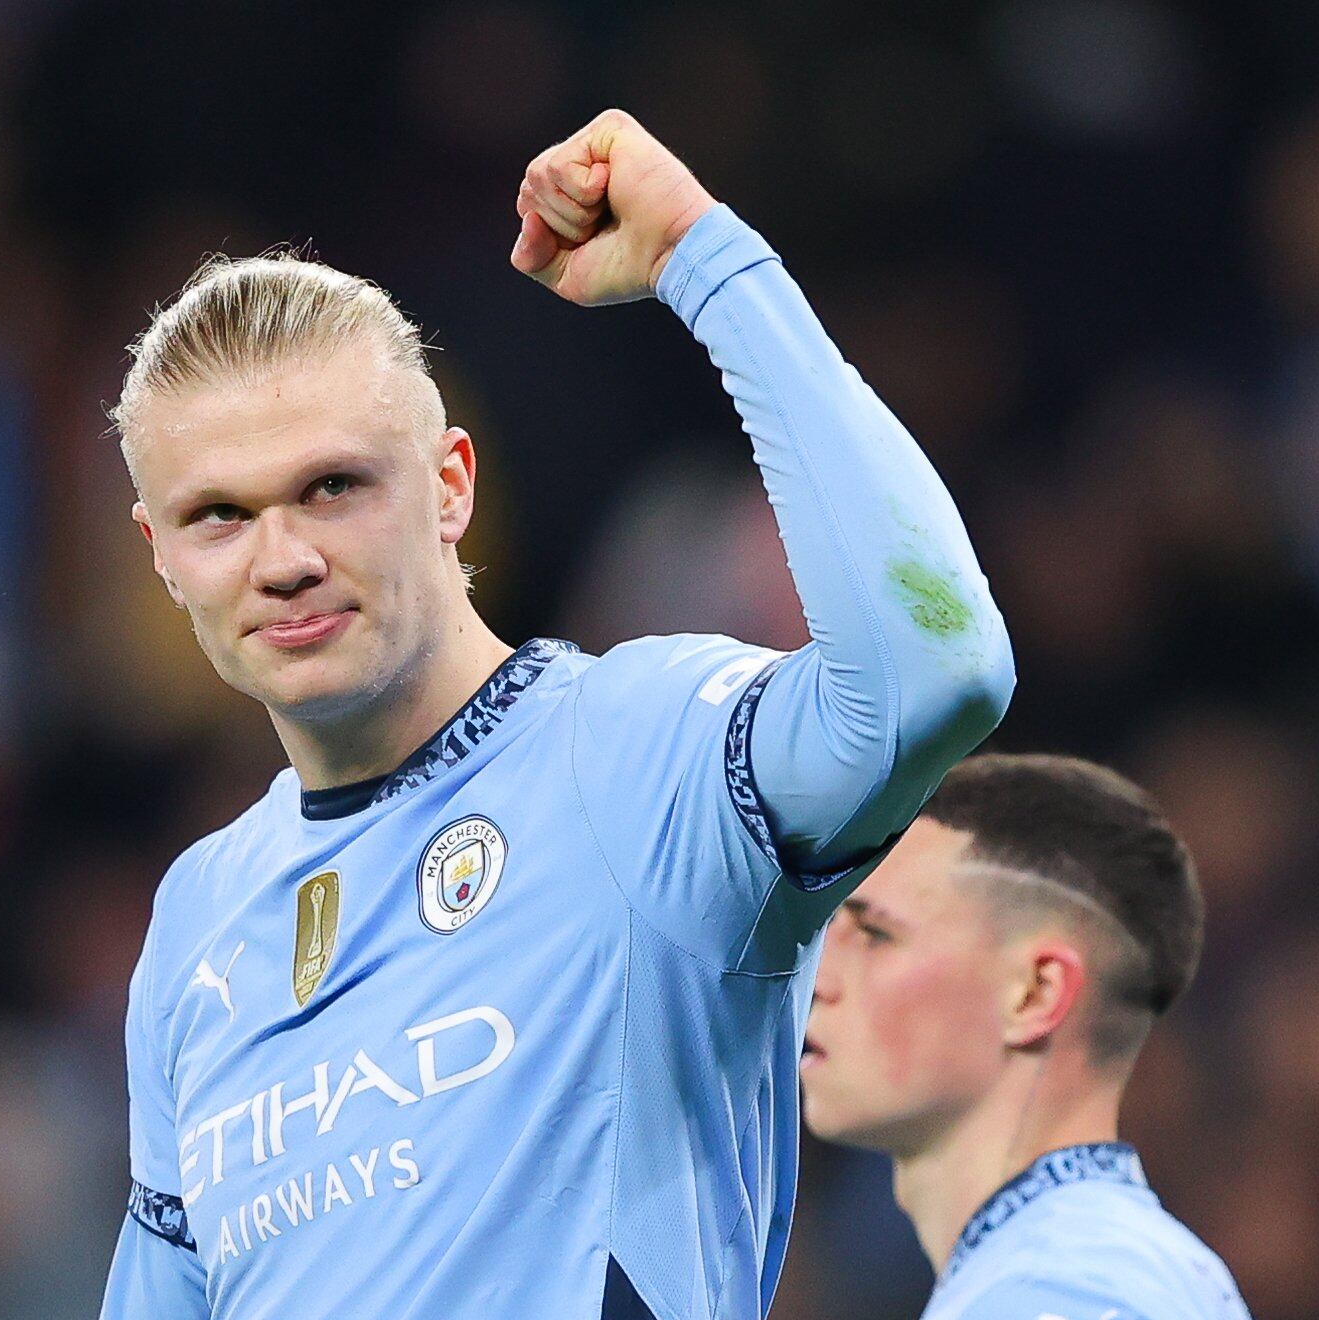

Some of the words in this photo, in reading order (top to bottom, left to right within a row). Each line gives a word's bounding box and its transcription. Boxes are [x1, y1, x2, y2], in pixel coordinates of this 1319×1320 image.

[426, 824, 498, 879] MANCHESTER
[450, 906, 476, 928] CITY
[178, 1005, 517, 1208] ETIHAD
[219, 1137, 423, 1265] AIRWAYS
